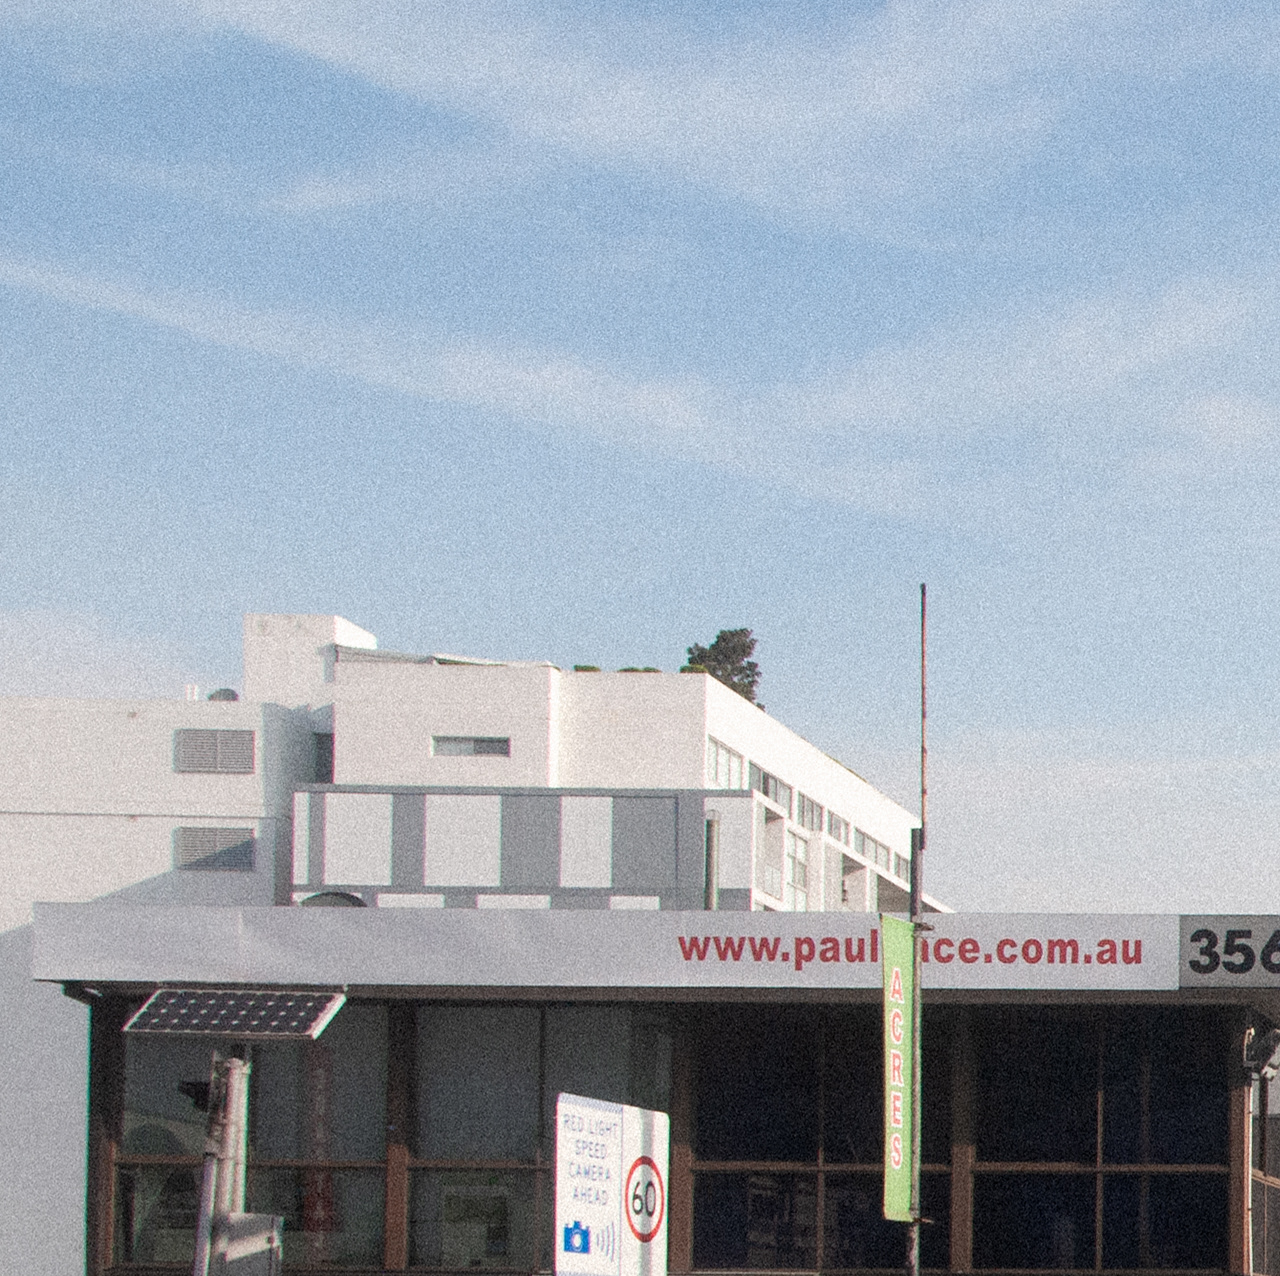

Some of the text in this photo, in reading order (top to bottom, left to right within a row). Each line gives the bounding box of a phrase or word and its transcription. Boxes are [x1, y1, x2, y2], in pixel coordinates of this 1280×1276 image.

[889, 966, 905, 1170] ACRES
[564, 1114, 617, 1139] RED LIGHT
[575, 1139, 606, 1159] SPEED
[569, 1162, 611, 1181] CAMERA
[573, 1188, 608, 1205] AHEAD
[632, 1181, 656, 1217] 60
